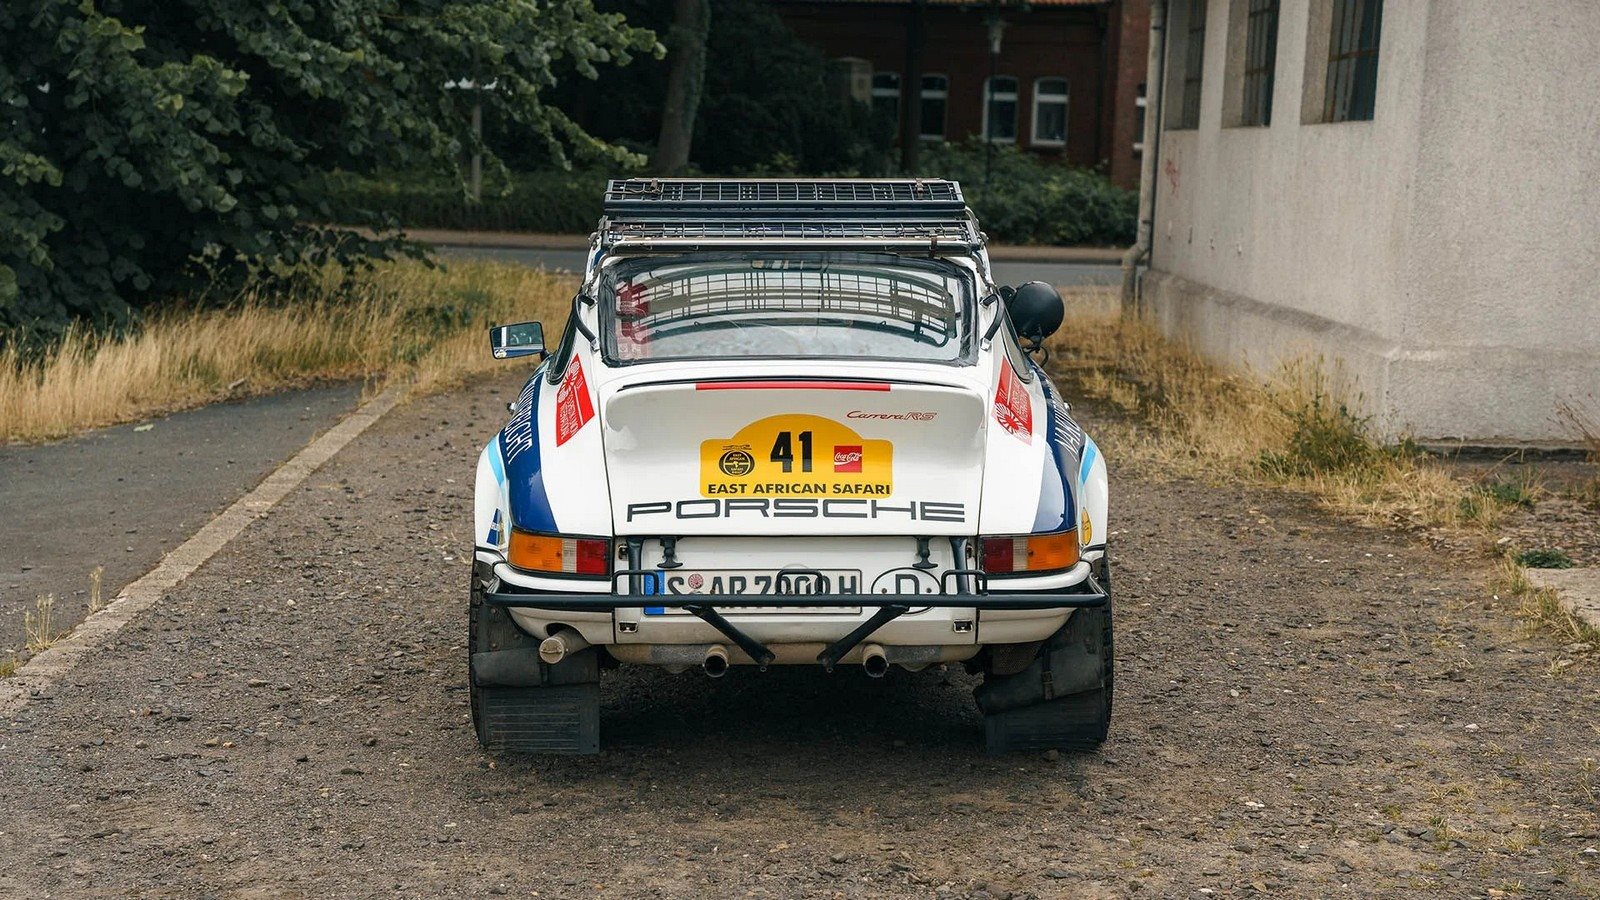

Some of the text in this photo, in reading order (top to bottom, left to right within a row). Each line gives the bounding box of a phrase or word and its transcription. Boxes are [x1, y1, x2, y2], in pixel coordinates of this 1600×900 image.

[770, 431, 813, 473] 41
[708, 484, 890, 495] EAST AFRICAN SAFARI
[627, 498, 965, 523] PORSCHE
